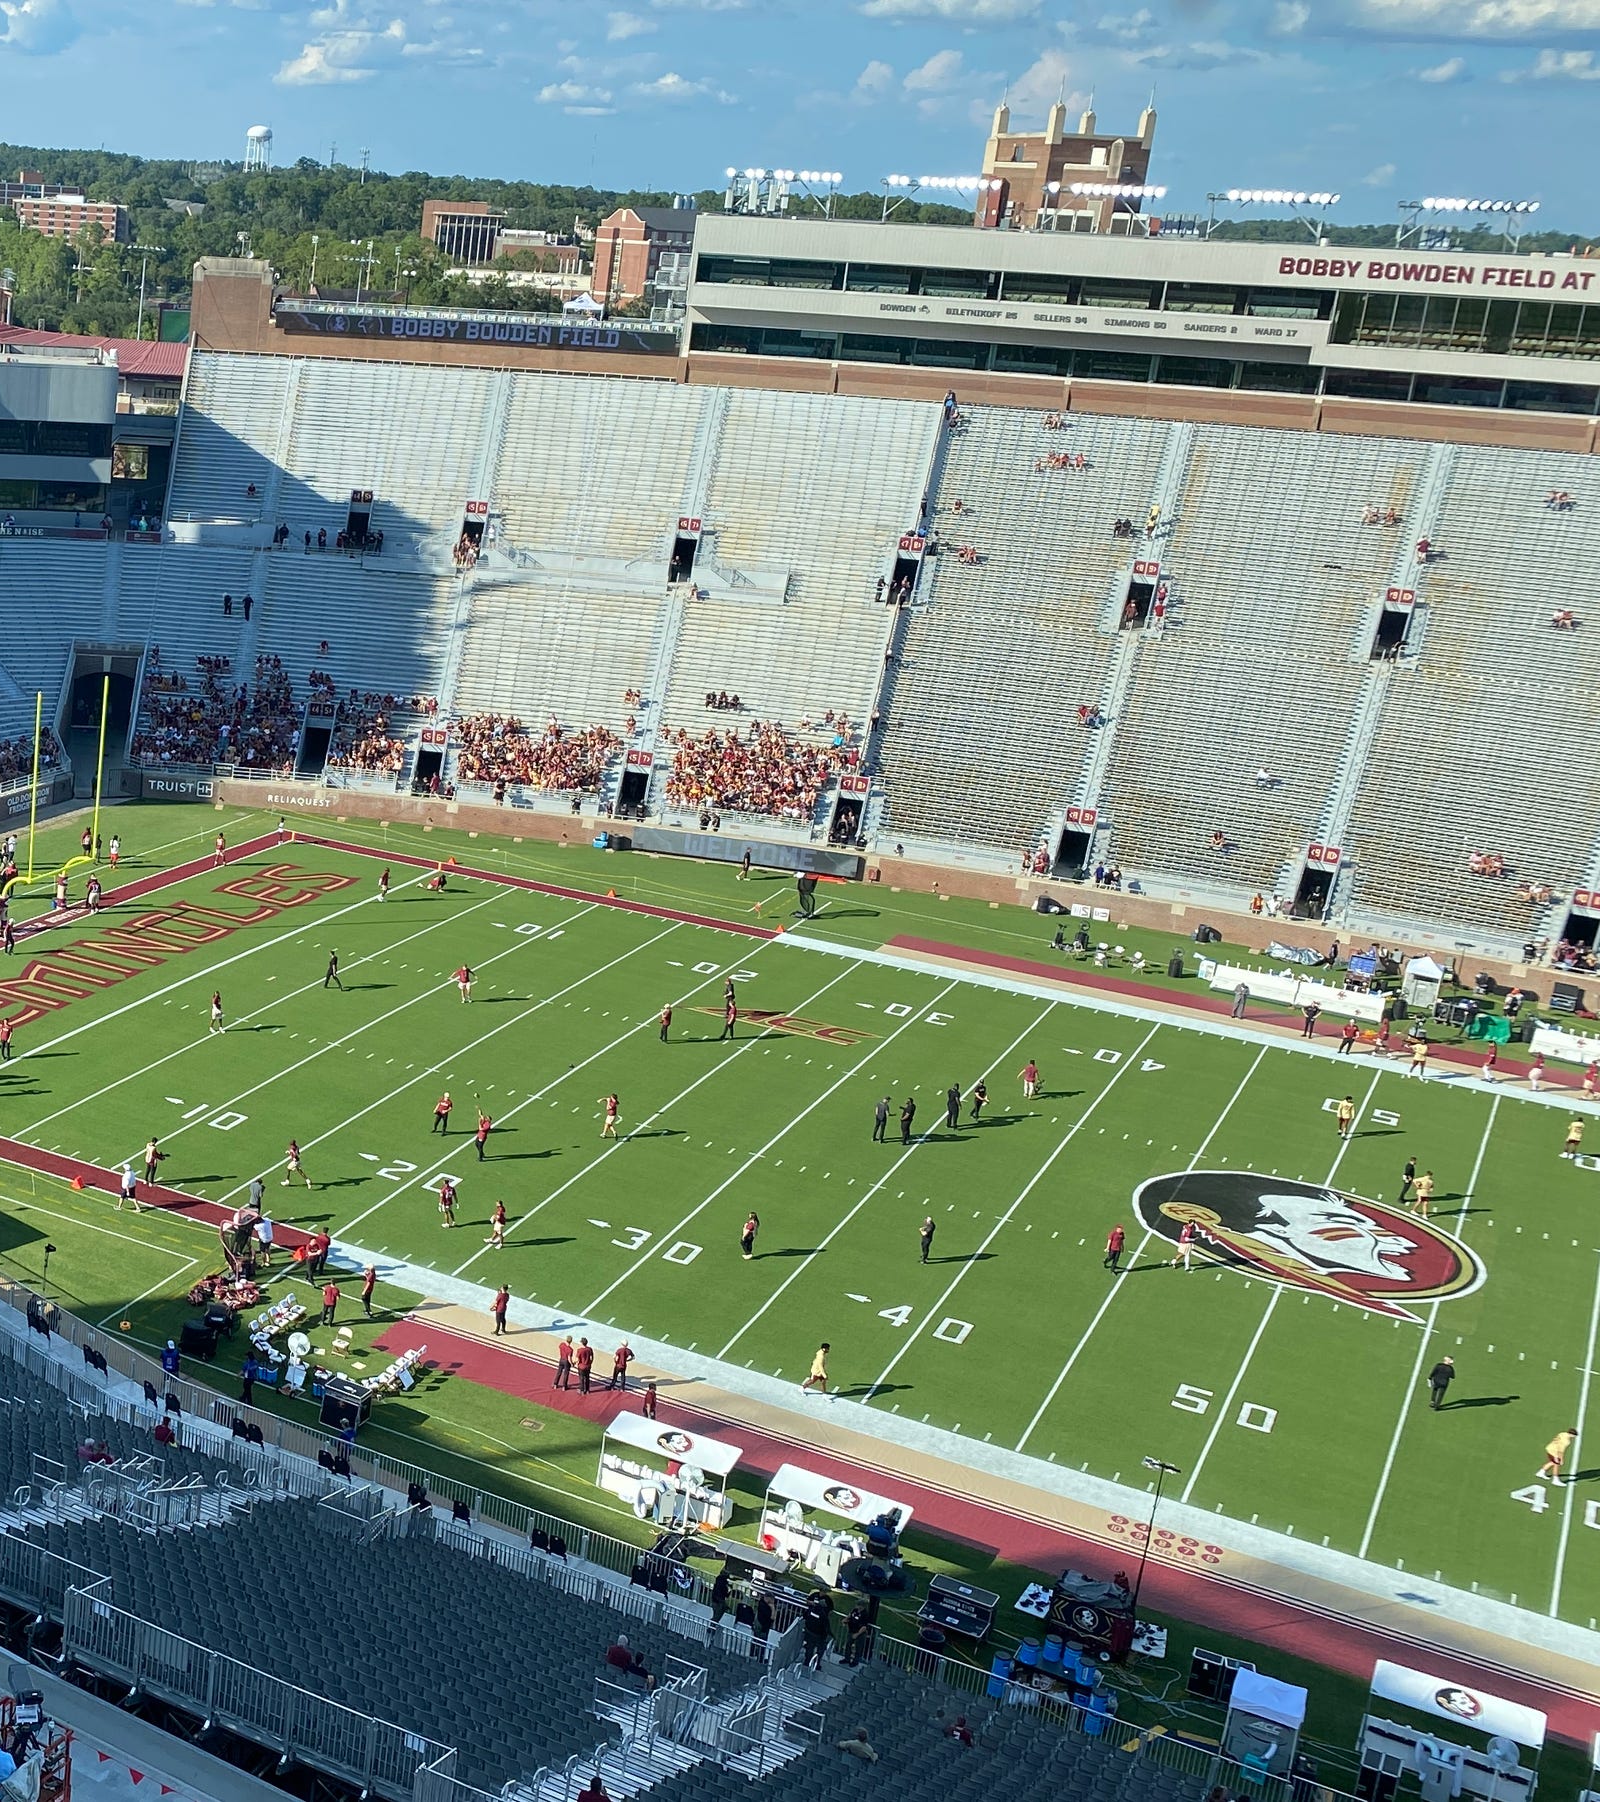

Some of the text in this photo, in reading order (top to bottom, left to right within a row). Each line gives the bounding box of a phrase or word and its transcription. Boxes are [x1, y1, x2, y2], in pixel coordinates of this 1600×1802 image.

[1279, 257, 1595, 290] BOBBY BOWDEN FIELD AT
[880, 303, 916, 313] BOWDEN
[945, 307, 1002, 319] BILETNIKOFF
[1033, 313, 1071, 324] SELLERS
[1104, 318, 1150, 329] SIMMONS
[391, 318, 619, 348] BOBBY BOWDEN FIELD
[1184, 323, 1227, 334] SANDERS
[1254, 327, 1298, 337] WARD 17
[14, 528, 44, 536] NISE
[149, 779, 194, 793] TRUIST
[7, 796, 20, 807] OLD
[267, 794, 331, 808] RELIAQUEST
[684, 833, 815, 868] WELCOME
[611, 1226, 704, 1266] 30
[878, 1304, 975, 1345] 40
[1170, 1383, 1278, 1434] 50
